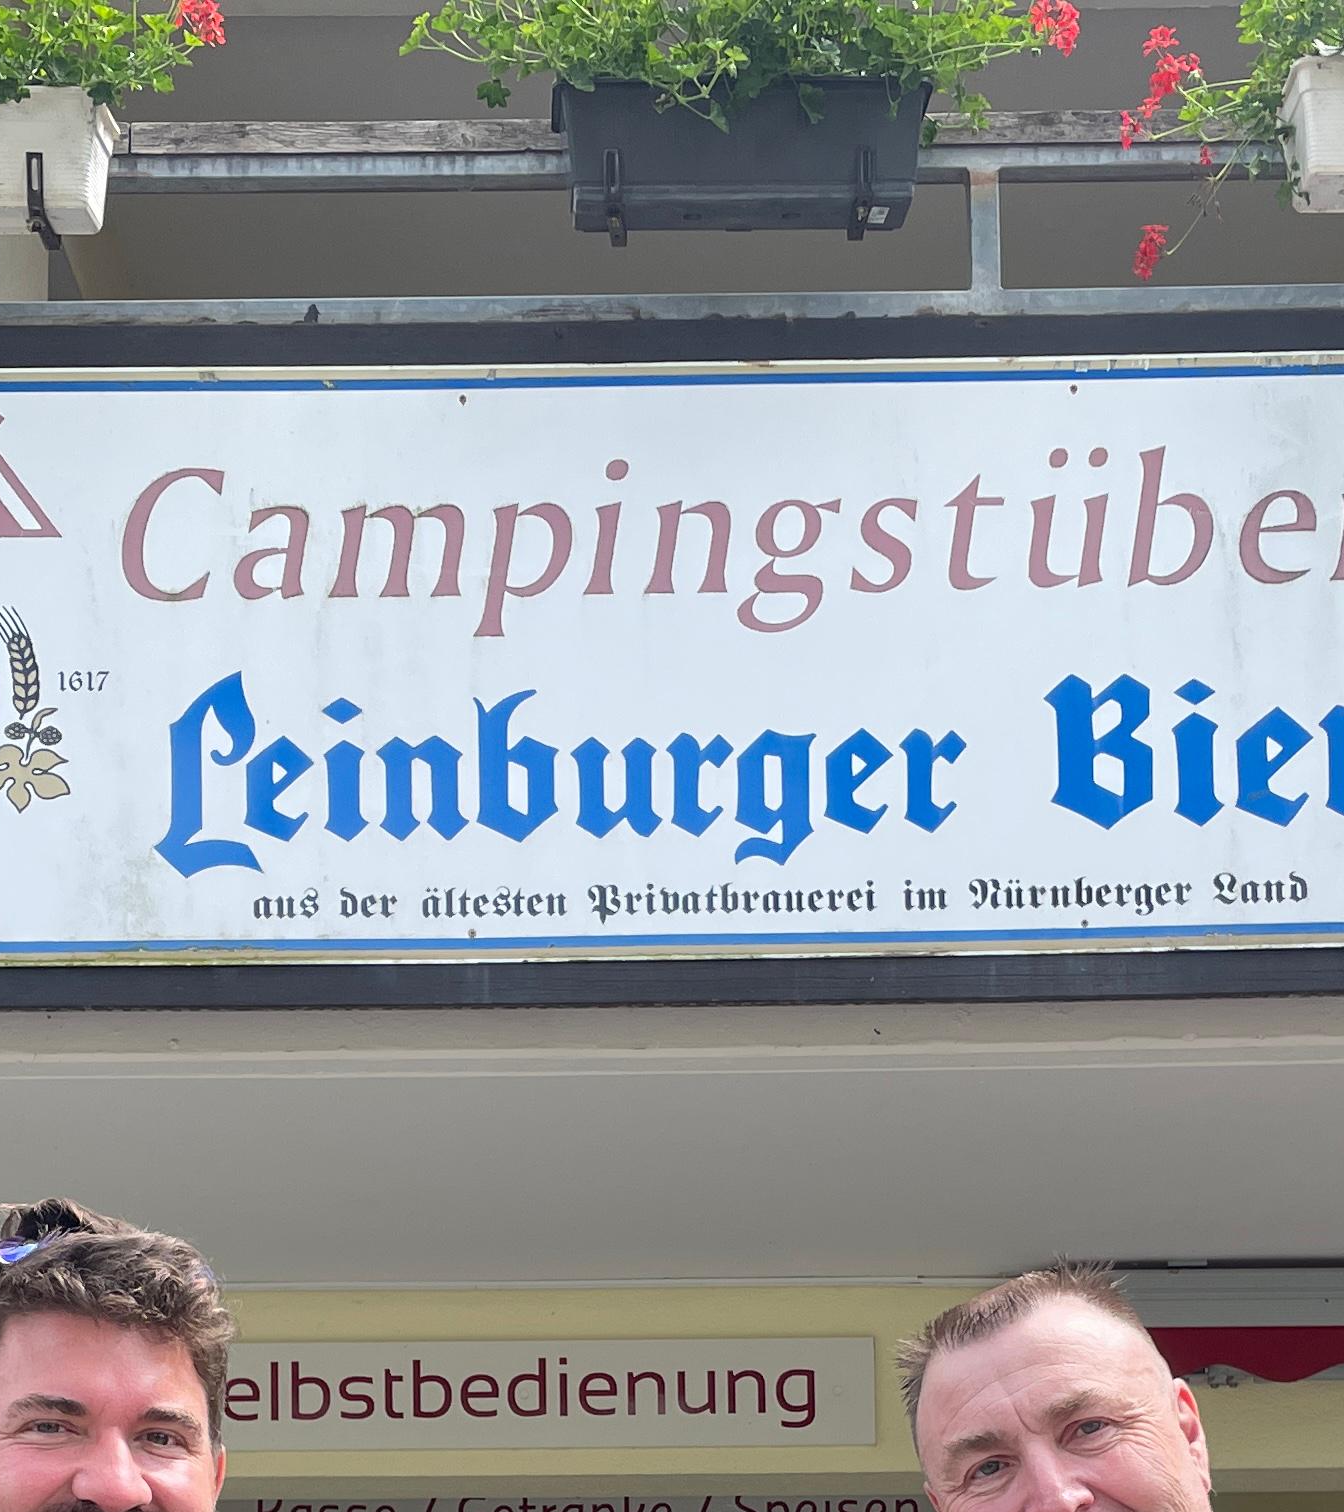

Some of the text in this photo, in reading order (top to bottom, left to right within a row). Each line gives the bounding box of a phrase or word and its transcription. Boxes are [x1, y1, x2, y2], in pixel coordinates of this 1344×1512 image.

[57, 670, 110, 692] 1617
[153, 671, 967, 877] Leinburger
[253, 871, 1309, 925] aus der ältesten Privatbrauerei im Nürnberger Land
[225, 1357, 817, 1428] elbstbedienung
